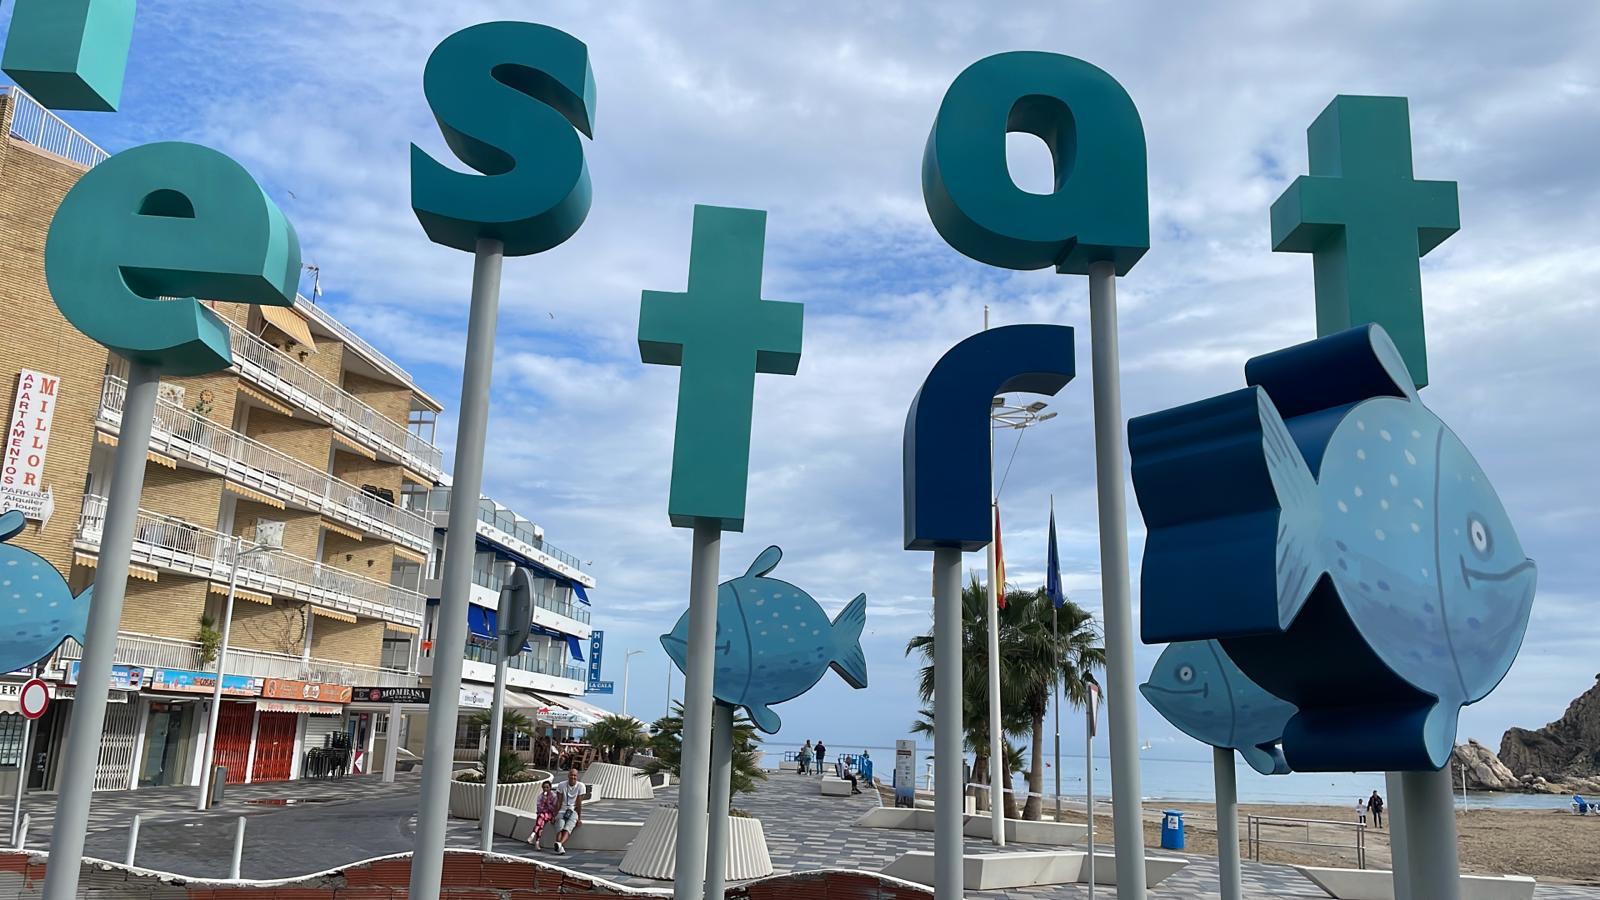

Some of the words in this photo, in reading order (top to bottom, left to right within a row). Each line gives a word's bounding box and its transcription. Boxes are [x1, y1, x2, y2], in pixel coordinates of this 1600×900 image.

[4, 374, 34, 484] APARTAMENTOS
[23, 377, 56, 486] MILLOR
[4, 495, 44, 506] Alquiler
[15, 502, 42, 511] louer
[591, 632, 601, 680] HOTEL
[381, 688, 426, 699] MOMBASA
